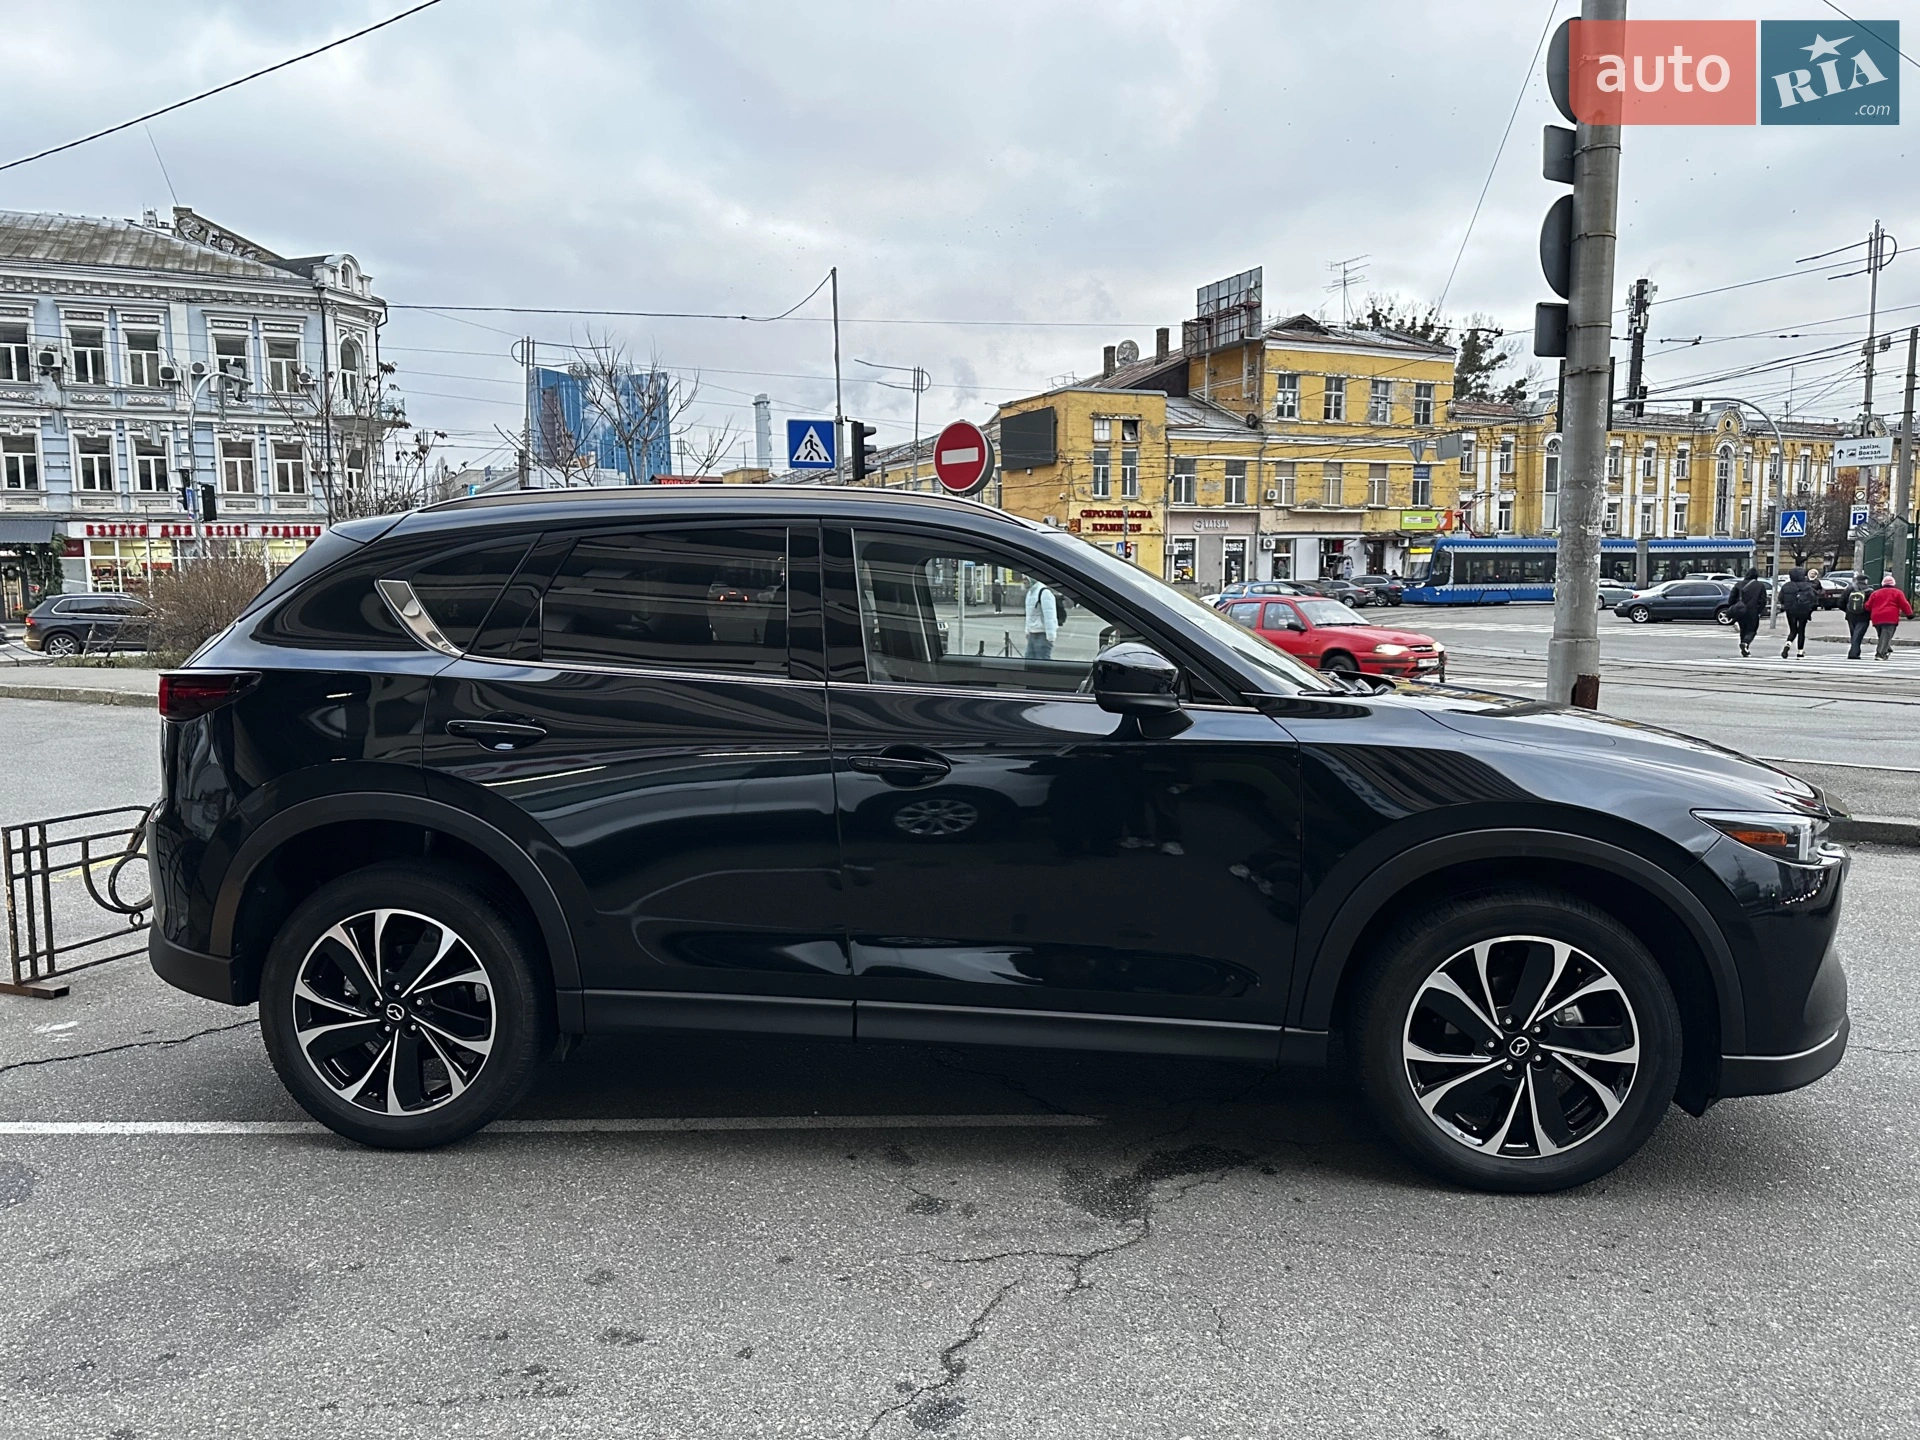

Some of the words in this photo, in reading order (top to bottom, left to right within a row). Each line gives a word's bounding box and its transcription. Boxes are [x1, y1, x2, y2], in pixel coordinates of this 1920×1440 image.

[1080, 509, 1153, 518] СИРО-КОВАСНА
[1092, 523, 1142, 532] КРАМНЦЯ
[1204, 519, 1230, 528] VATSAK
[86, 524, 147, 537] ВЗУТТЯ
[161, 525, 193, 538] ДЛЯ
[205, 523, 249, 537] ВСІЄЇ
[261, 525, 321, 538] РОДИНИ
